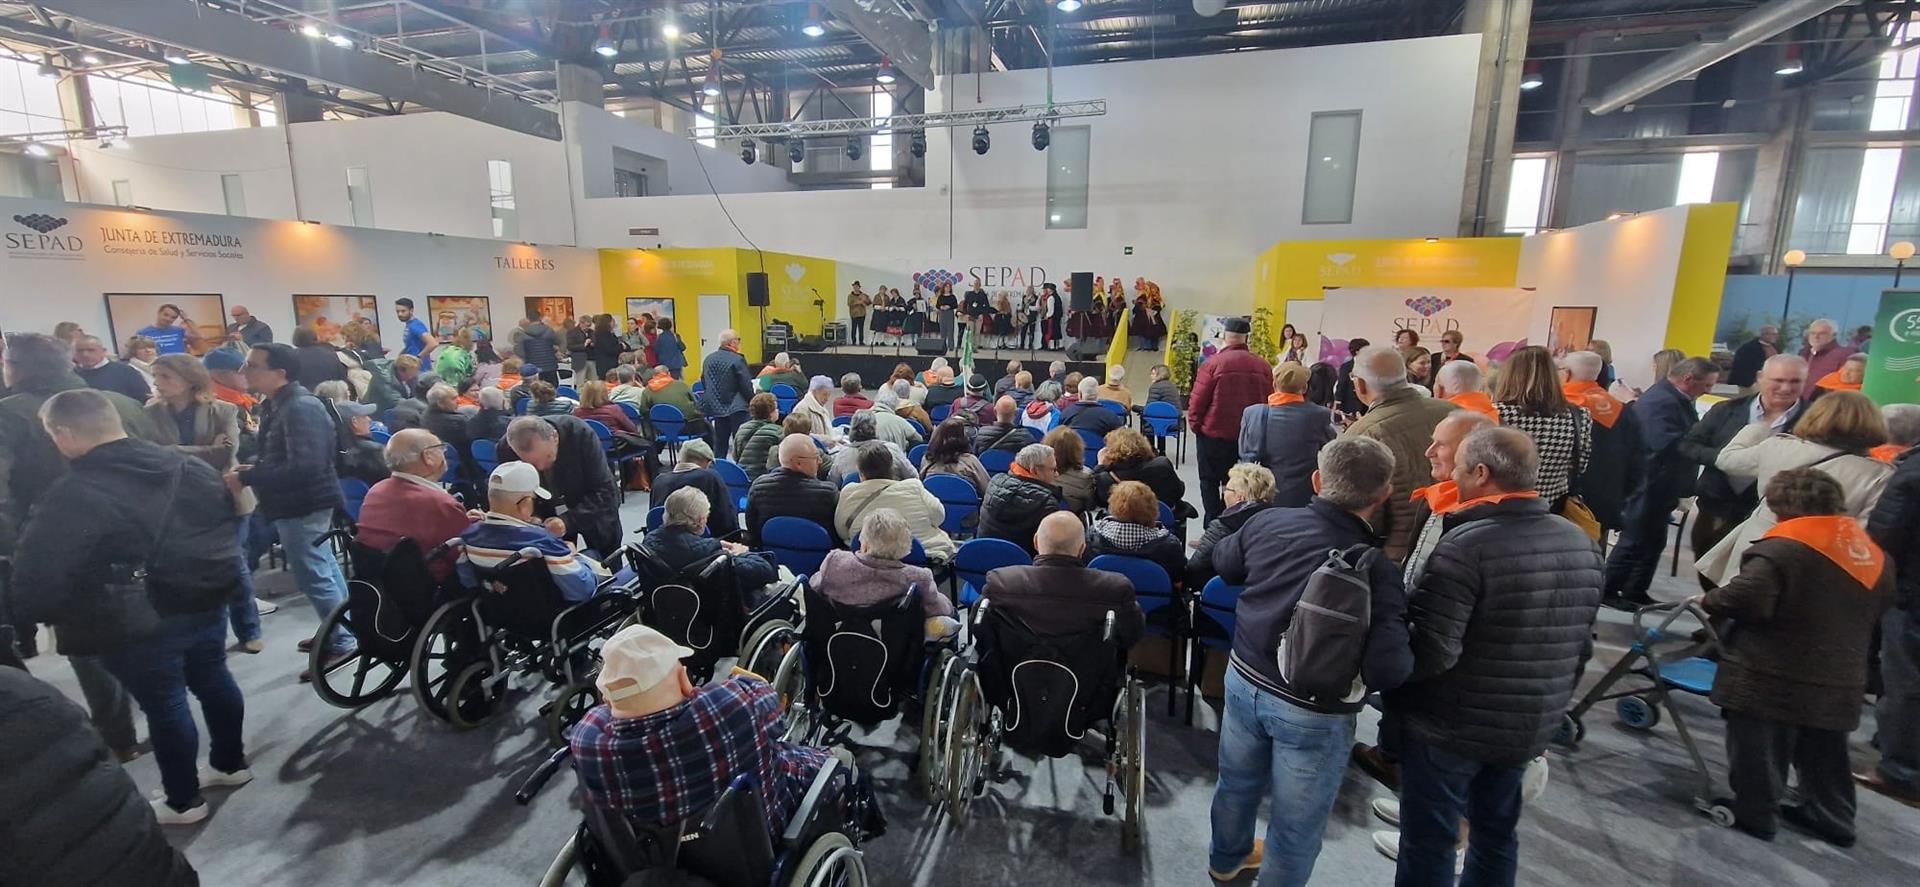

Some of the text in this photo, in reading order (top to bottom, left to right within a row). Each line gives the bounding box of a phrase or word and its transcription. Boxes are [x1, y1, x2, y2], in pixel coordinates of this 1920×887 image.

[5, 232, 83, 251] SEPAD
[100, 227, 242, 248] JUNTA DE EXTREMADURA
[148, 248, 158, 256] de
[160, 248, 179, 257] Salud
[218, 250, 244, 260] Sociales
[493, 256, 555, 271] TALLERES
[968, 266, 1046, 287] SEPAD
[1391, 317, 1460, 335] SEPAD
